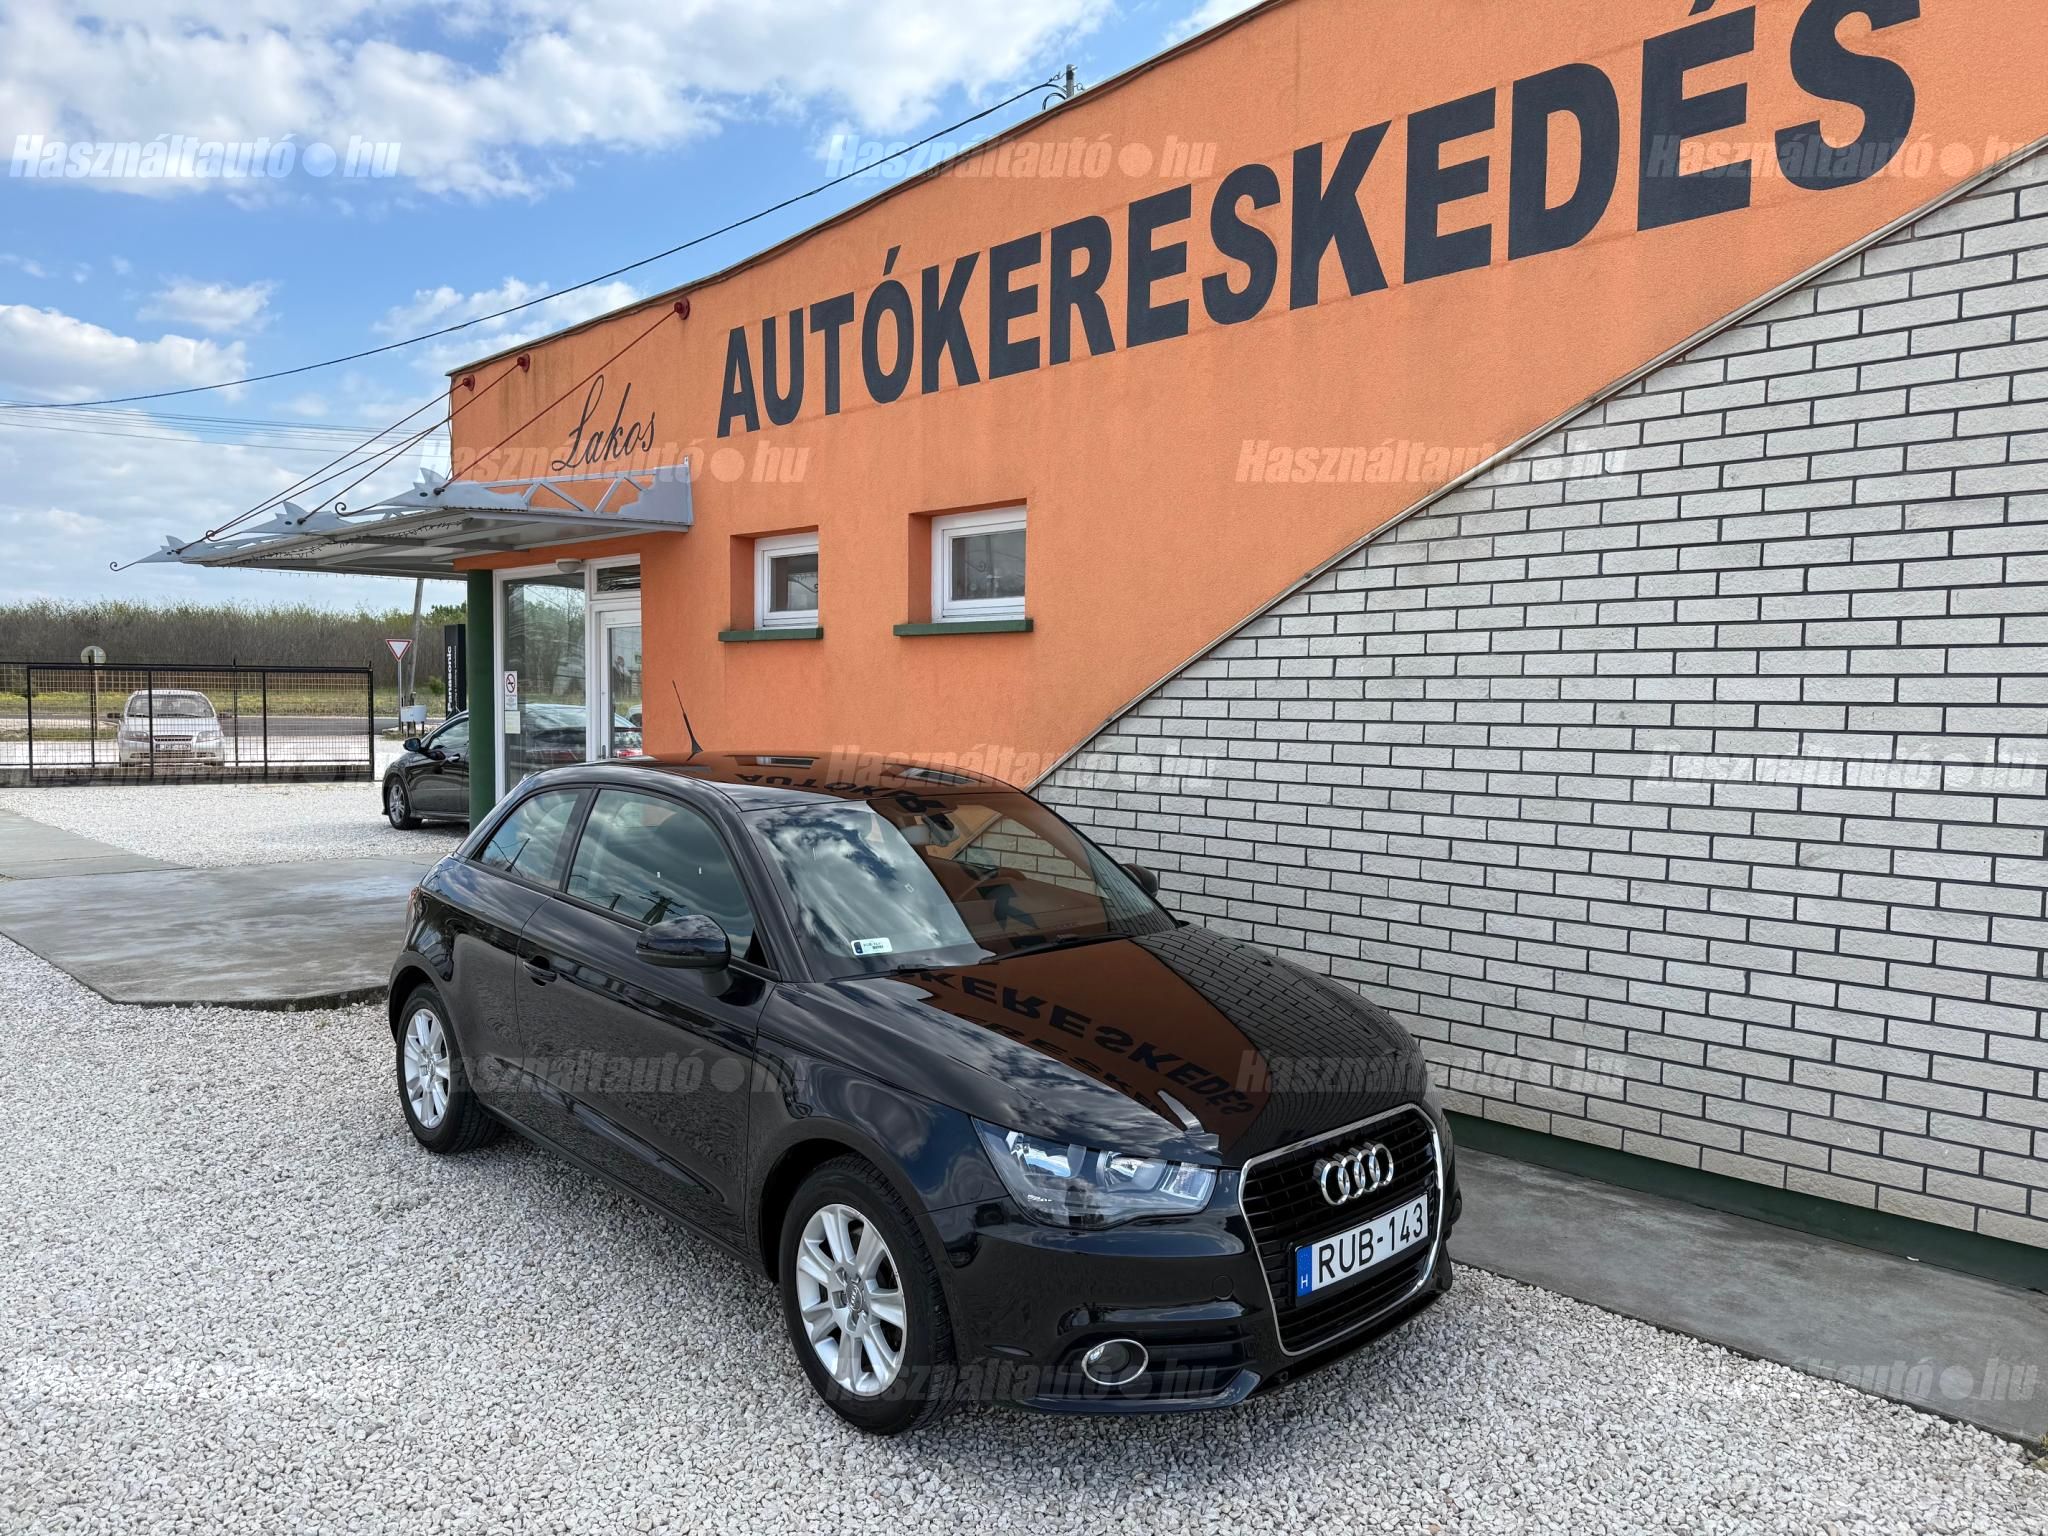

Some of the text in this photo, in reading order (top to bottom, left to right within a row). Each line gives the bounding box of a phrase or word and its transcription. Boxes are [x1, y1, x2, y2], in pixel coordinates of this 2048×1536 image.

[717, 0, 1921, 439] AUTÓKERESKEDÉS
[551, 374, 656, 471] Lakos
[1300, 1202, 1424, 1289] H RUB-143
